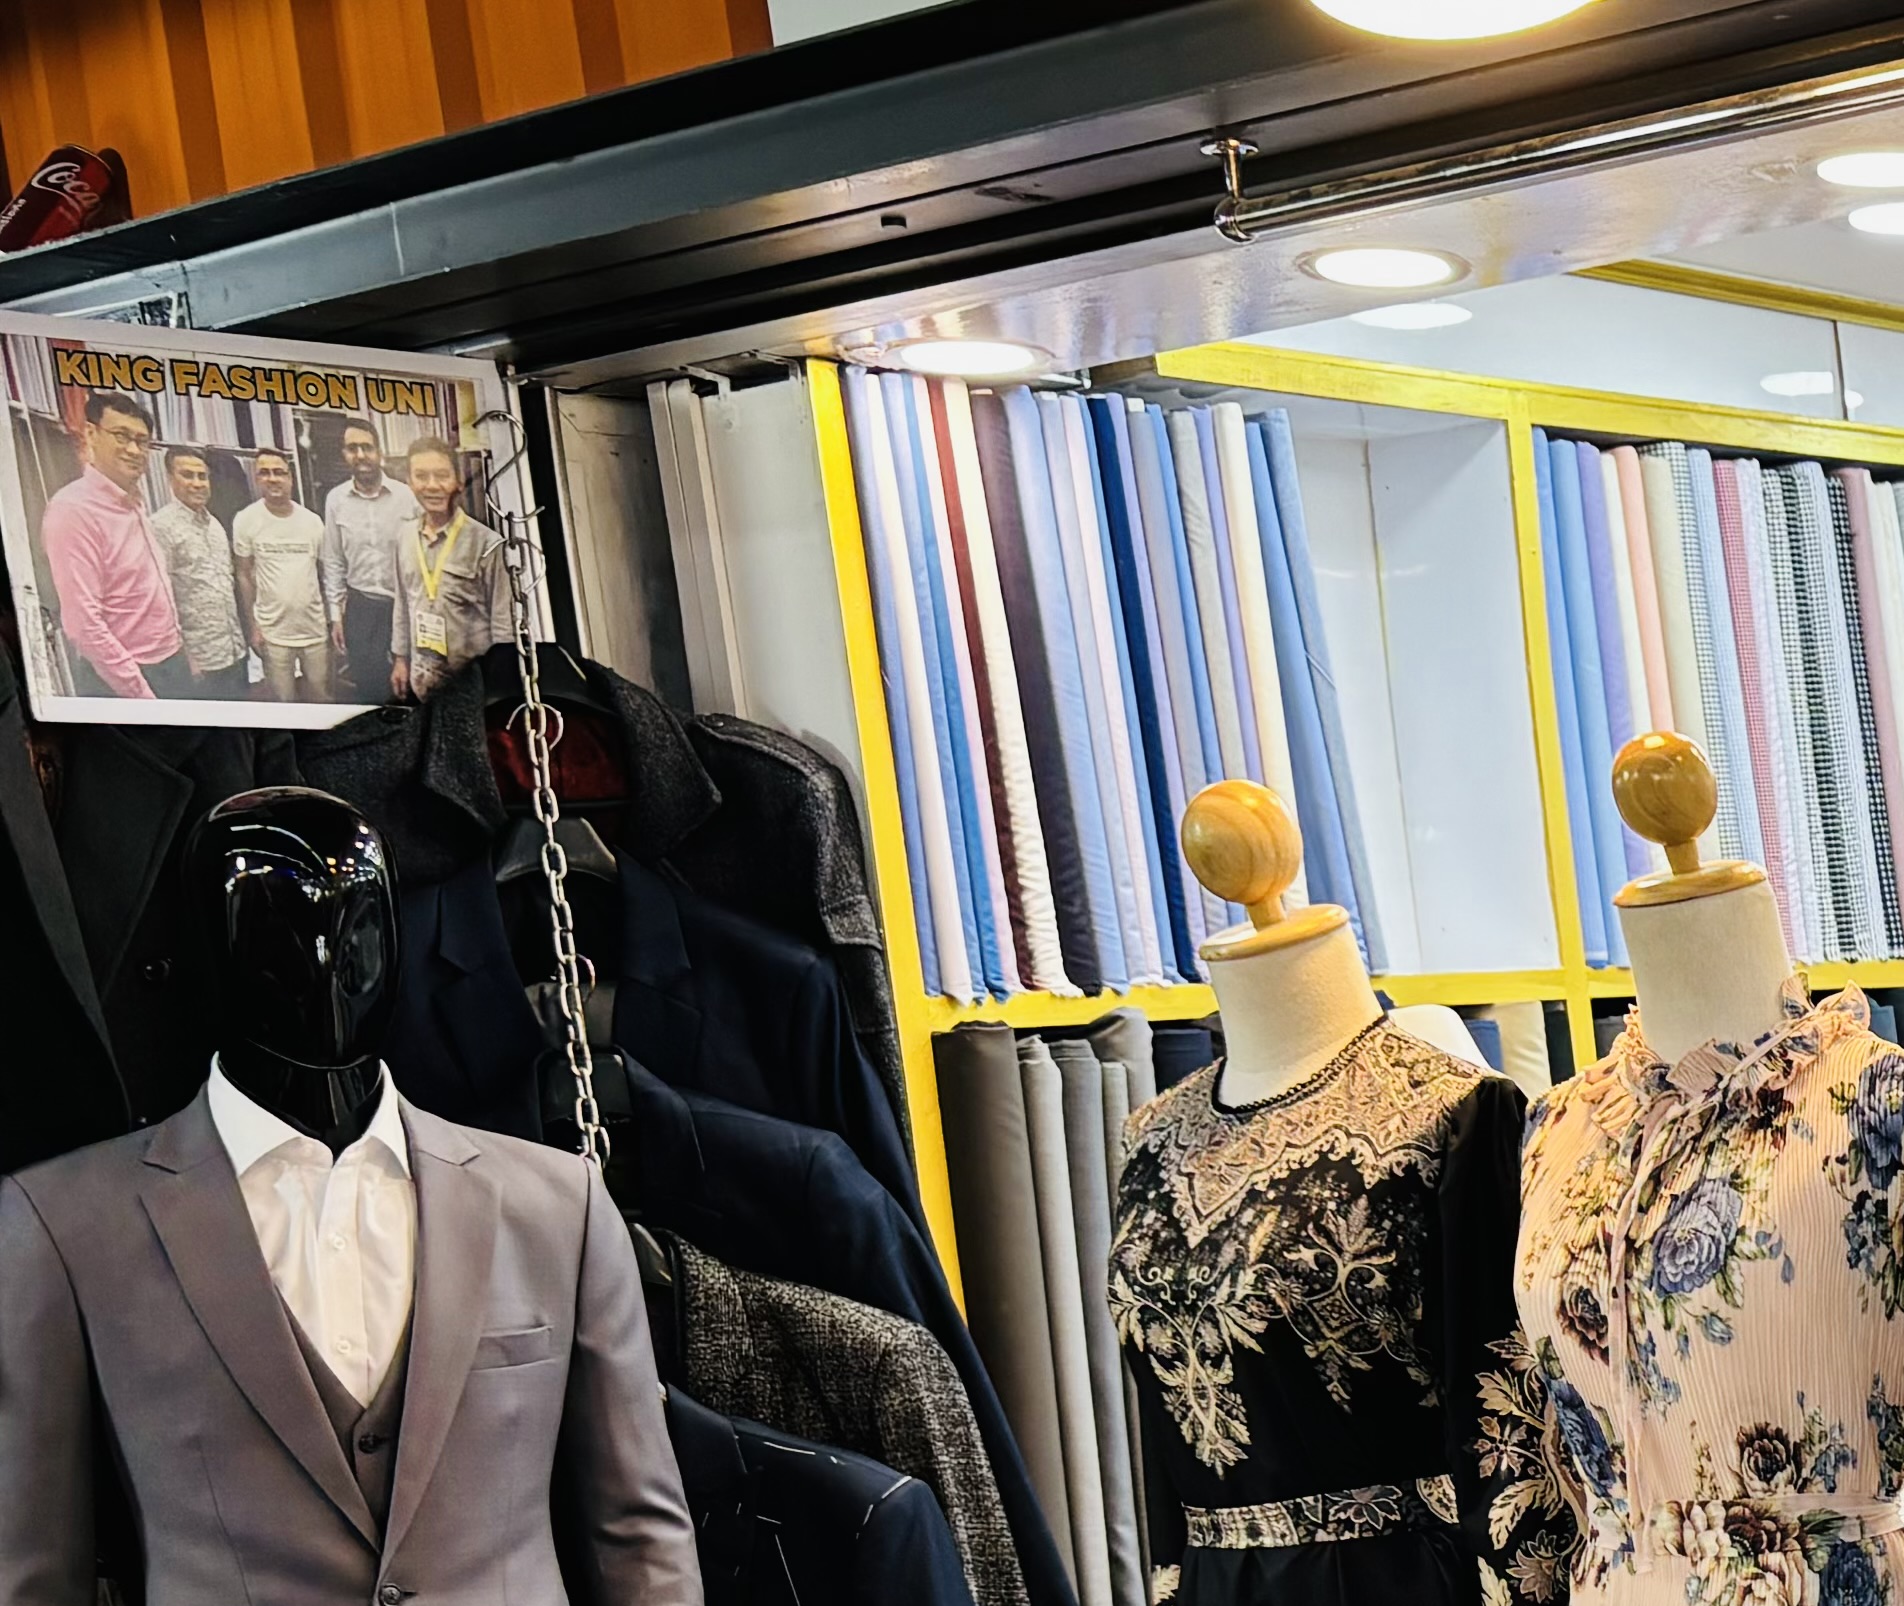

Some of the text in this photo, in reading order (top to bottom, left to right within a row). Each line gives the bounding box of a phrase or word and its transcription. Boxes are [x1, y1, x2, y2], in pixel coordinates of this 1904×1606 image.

[53, 348, 437, 418] KING FASHION UNI
